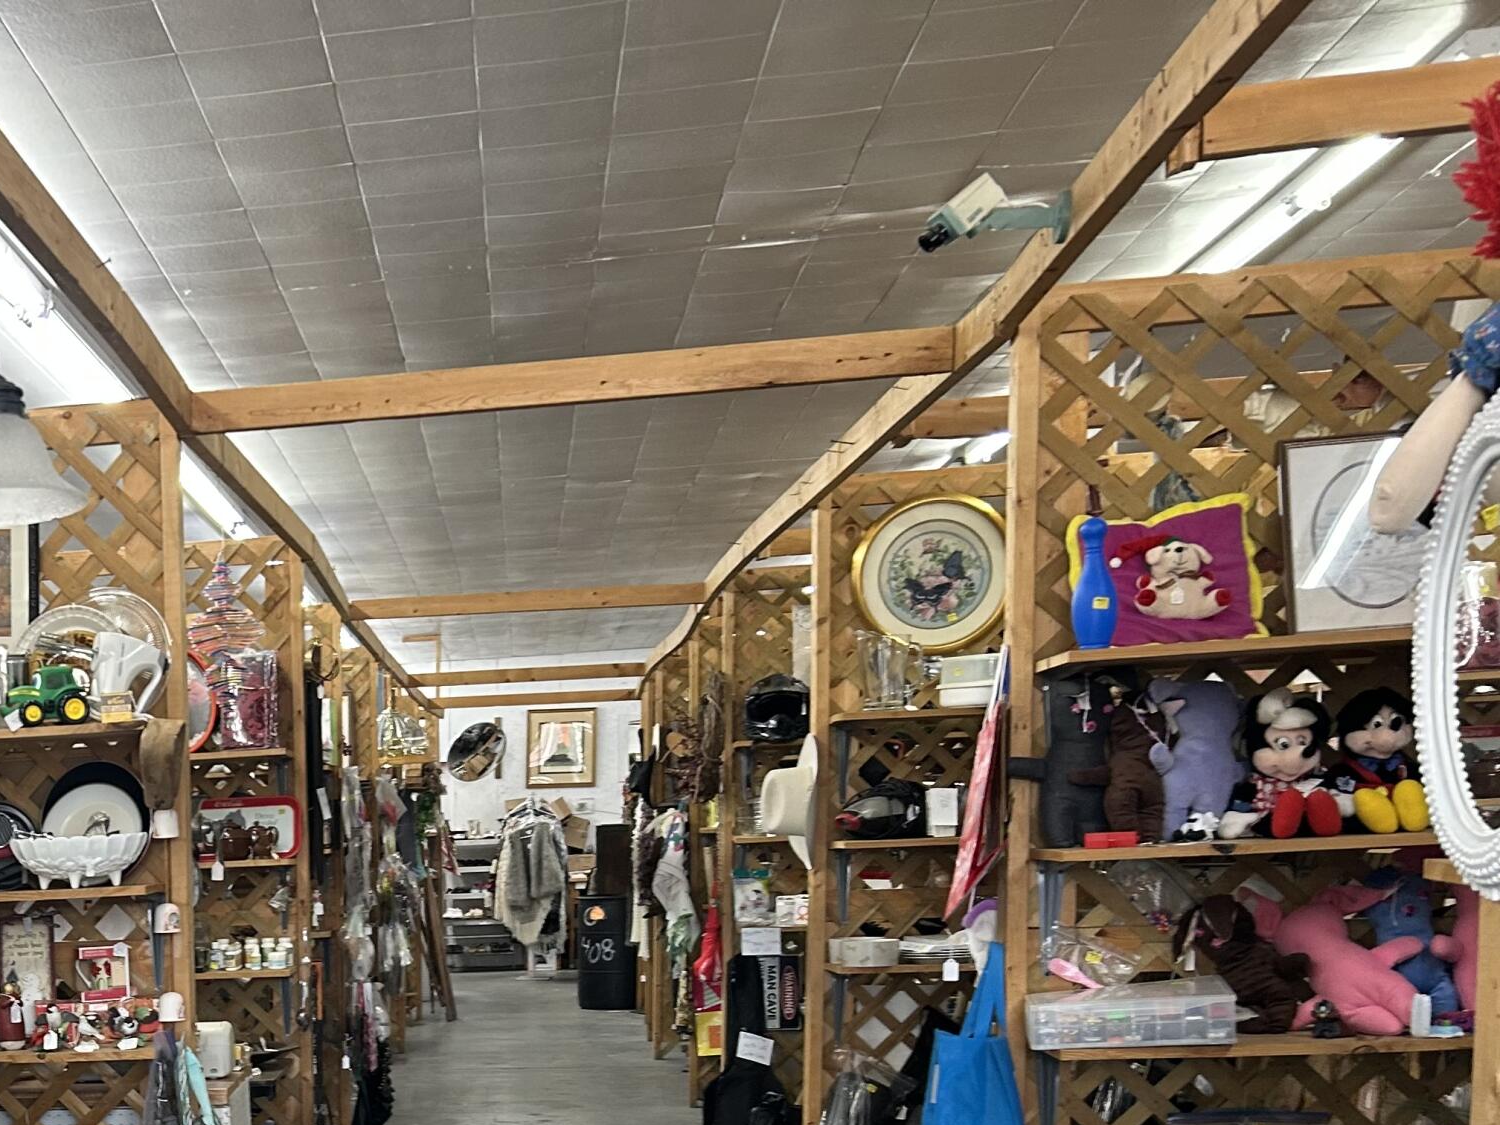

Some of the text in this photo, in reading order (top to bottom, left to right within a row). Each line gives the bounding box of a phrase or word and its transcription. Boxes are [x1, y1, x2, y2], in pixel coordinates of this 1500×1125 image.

[581, 936, 615, 963] 408
[766, 965, 778, 1021] MAN CAVE
